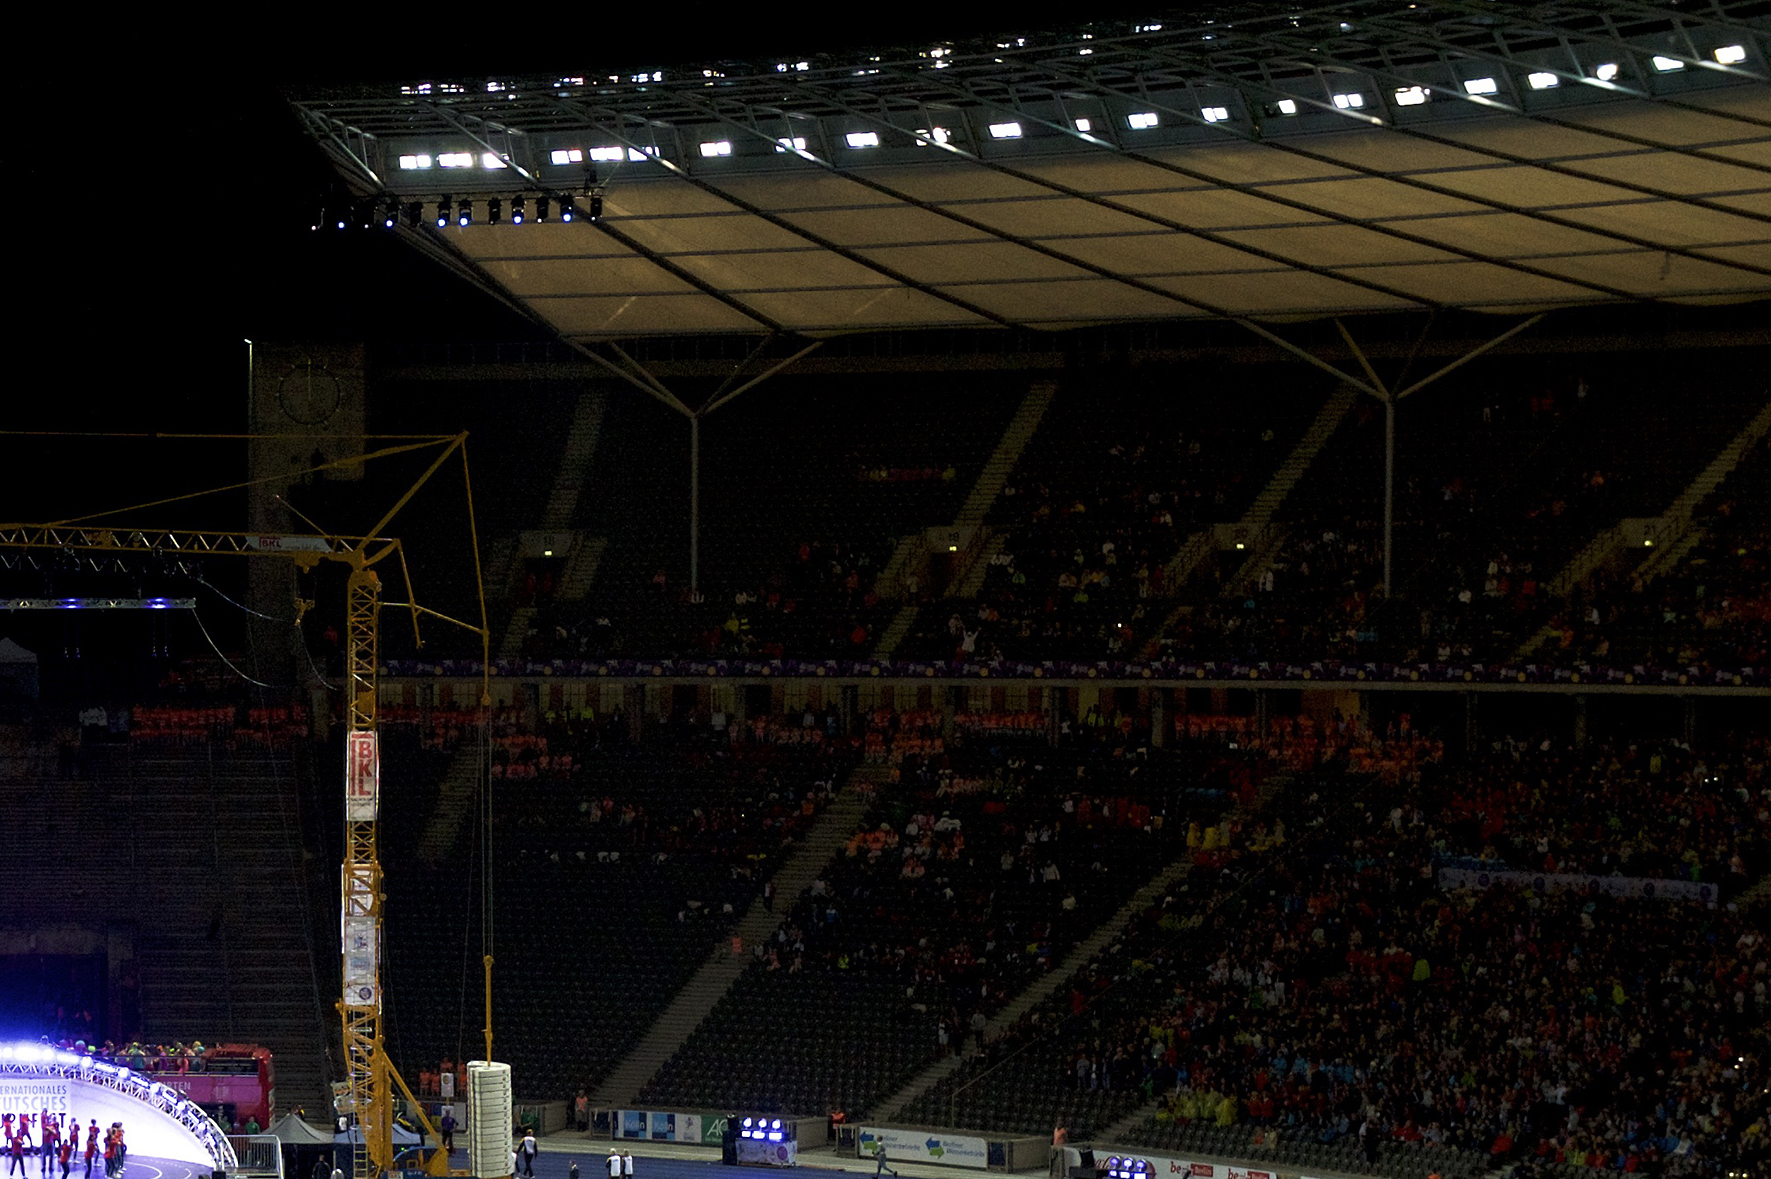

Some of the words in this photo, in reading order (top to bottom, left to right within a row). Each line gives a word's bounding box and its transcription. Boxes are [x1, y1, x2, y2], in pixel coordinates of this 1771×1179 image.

[262, 540, 281, 548] BKL
[359, 741, 373, 796] BKL
[1170, 1161, 1182, 1174] be
